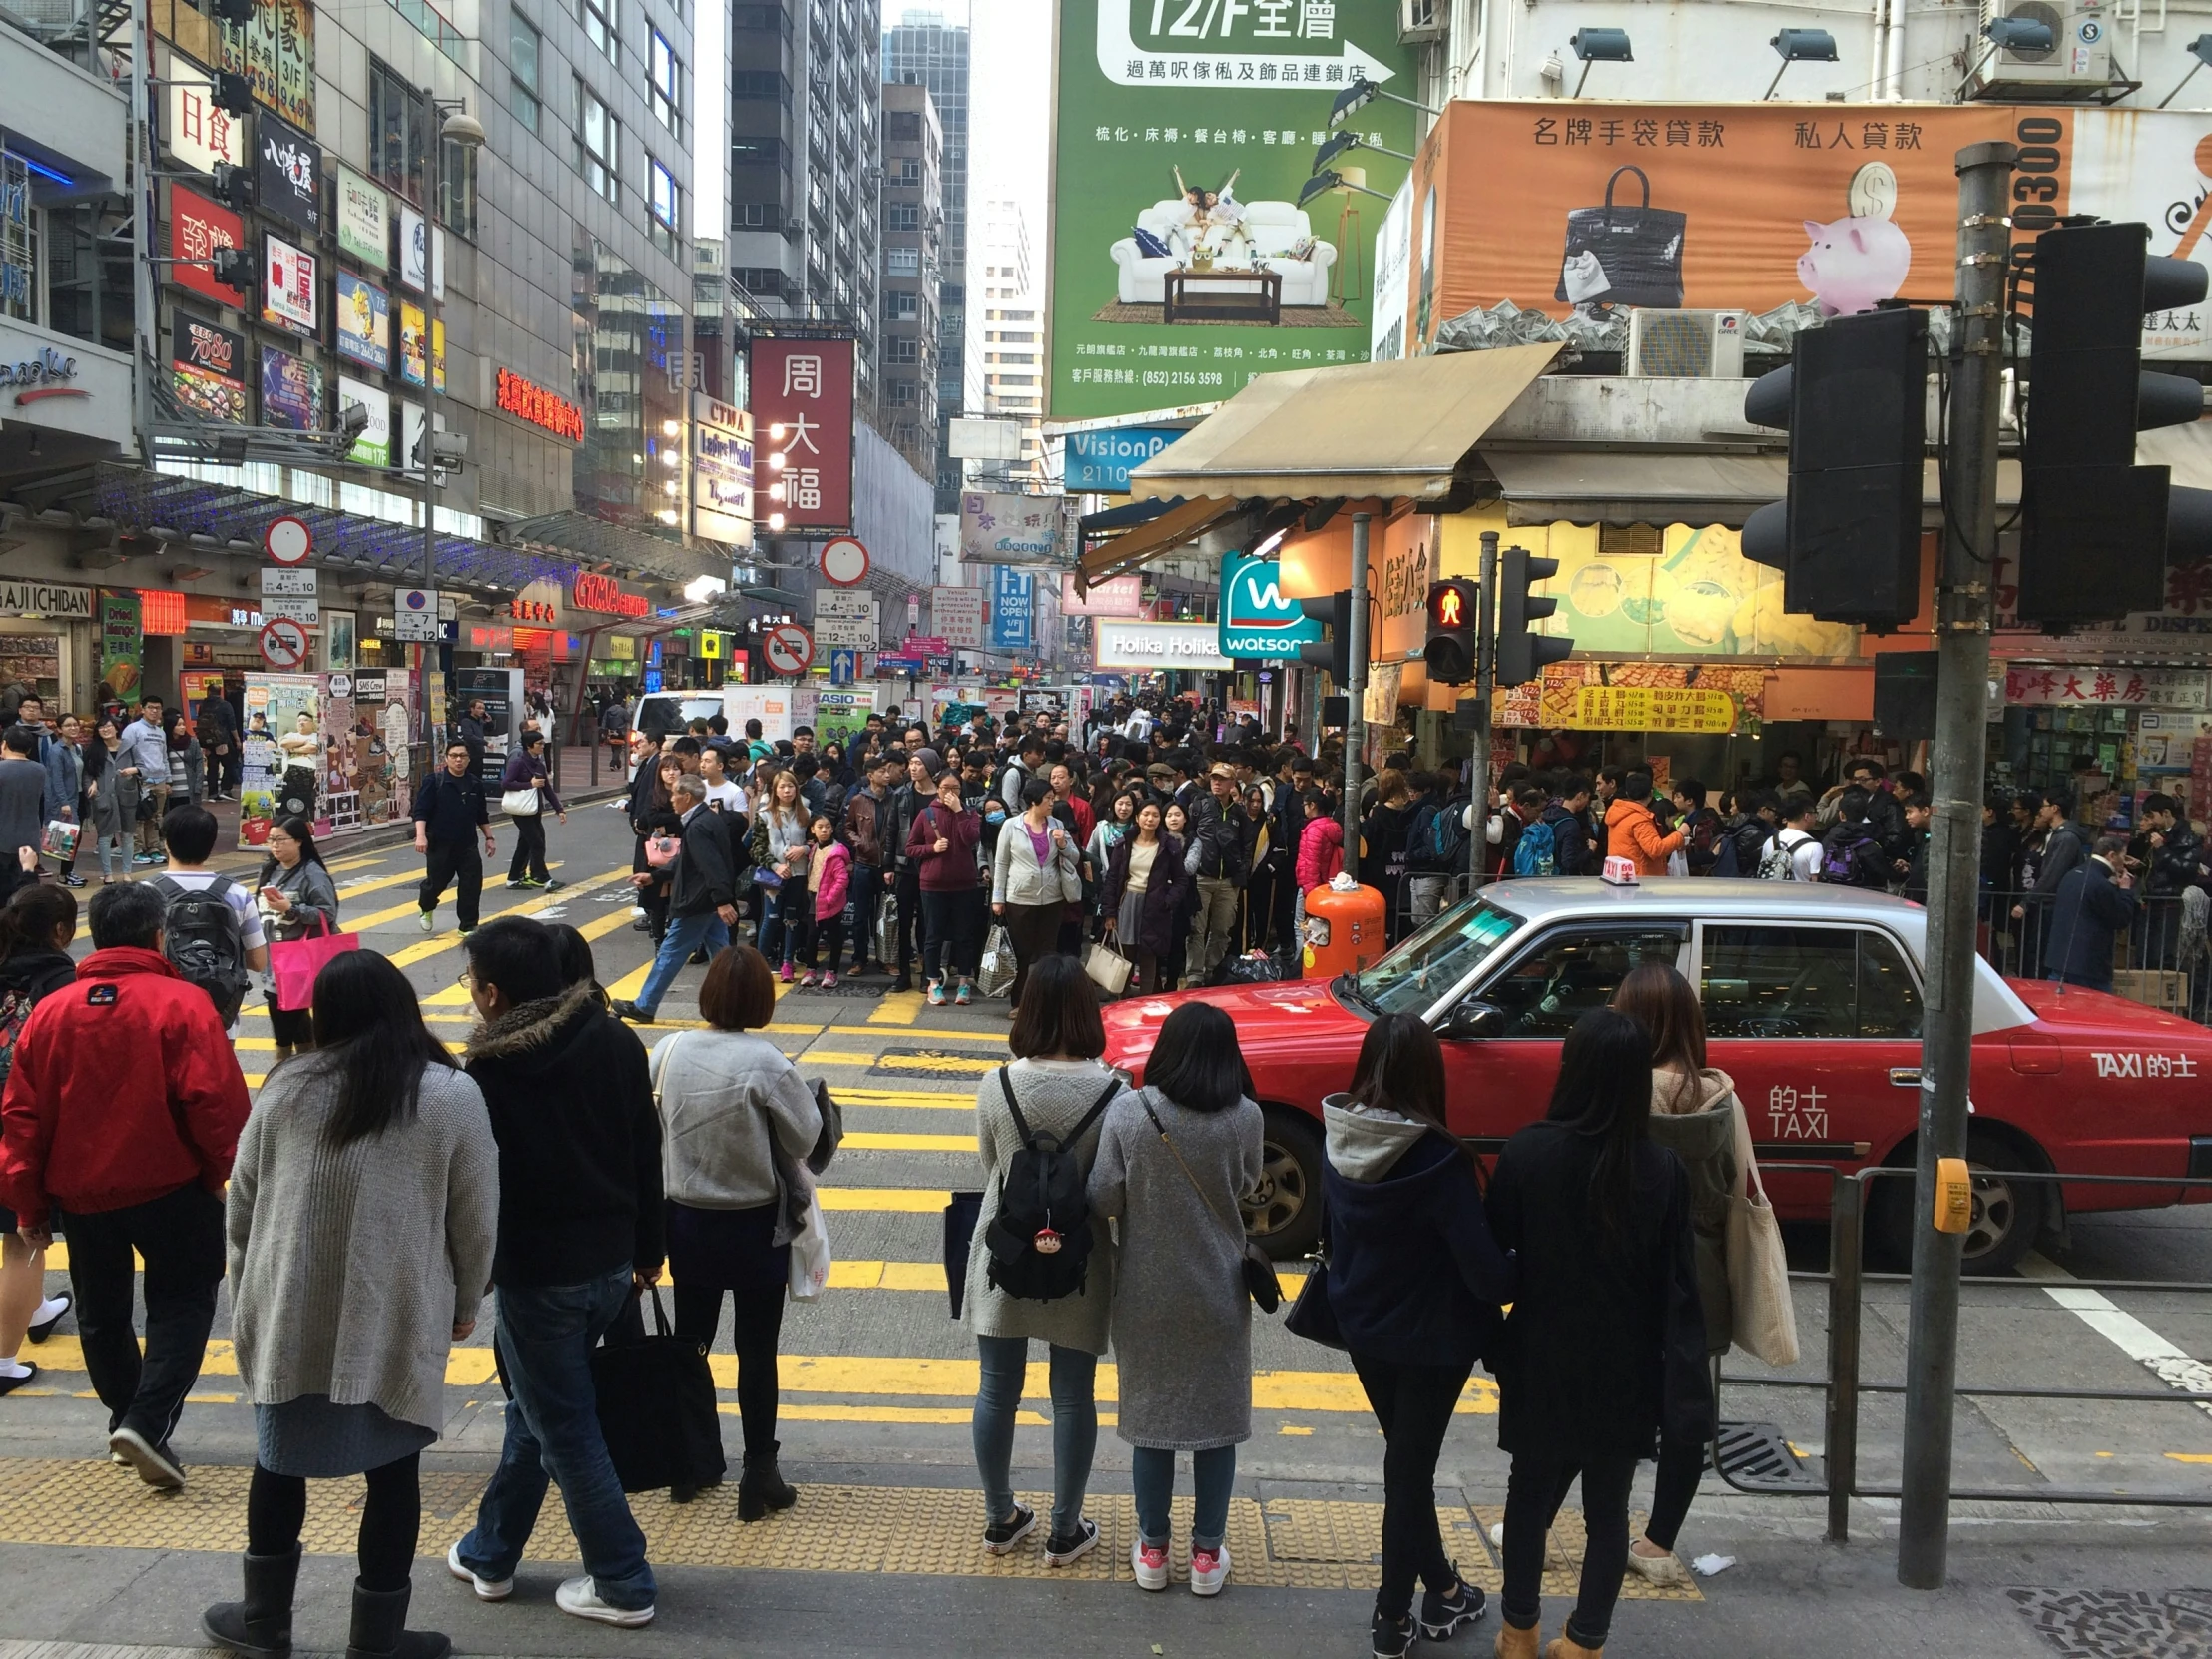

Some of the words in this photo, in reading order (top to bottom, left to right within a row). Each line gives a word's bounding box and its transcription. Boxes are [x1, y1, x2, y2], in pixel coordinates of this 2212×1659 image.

[282, 60, 301, 89] 3/F
[183, 88, 231, 162] 日食
[1533, 118, 1725, 148] 名牌手袋貸款
[1794, 122, 1922, 150] 私人貸款
[307, 208, 318, 224] 9/F
[1258, 347, 1278, 359] 北角
[1292, 349, 1312, 359] 旺角
[1143, 371, 1169, 387] (852)
[1172, 373, 1195, 385] 2156
[1198, 373, 1222, 385] 3598
[781, 355, 821, 509] 周大福
[1074, 434, 1169, 458] VisionP
[373, 448, 387, 467] 17F
[5, 586, 29, 611] AJI
[34, 587, 90, 615] ICHIBAN
[575, 573, 619, 613] CTMA
[1000, 597, 1028, 607] NOW
[108, 606, 132, 621] Dried
[421, 615, 429, 625] 7
[511, 599, 555, 623] 兆萬中心
[1000, 607, 1028, 617] OPEN
[423, 631, 436, 641] 12
[858, 633, 870, 643] 10
[1112, 635, 1163, 655] Holika
[1170, 636, 1220, 655] Holika
[370, 681, 383, 690] Crew
[1605, 860, 1617, 878] TAXI
[2090, 1052, 2143, 1078] TAXI
[2146, 1054, 2198, 1078] 的士
[1769, 1084, 1828, 1112] 的士
[1767, 1112, 1829, 1139] TAXI
